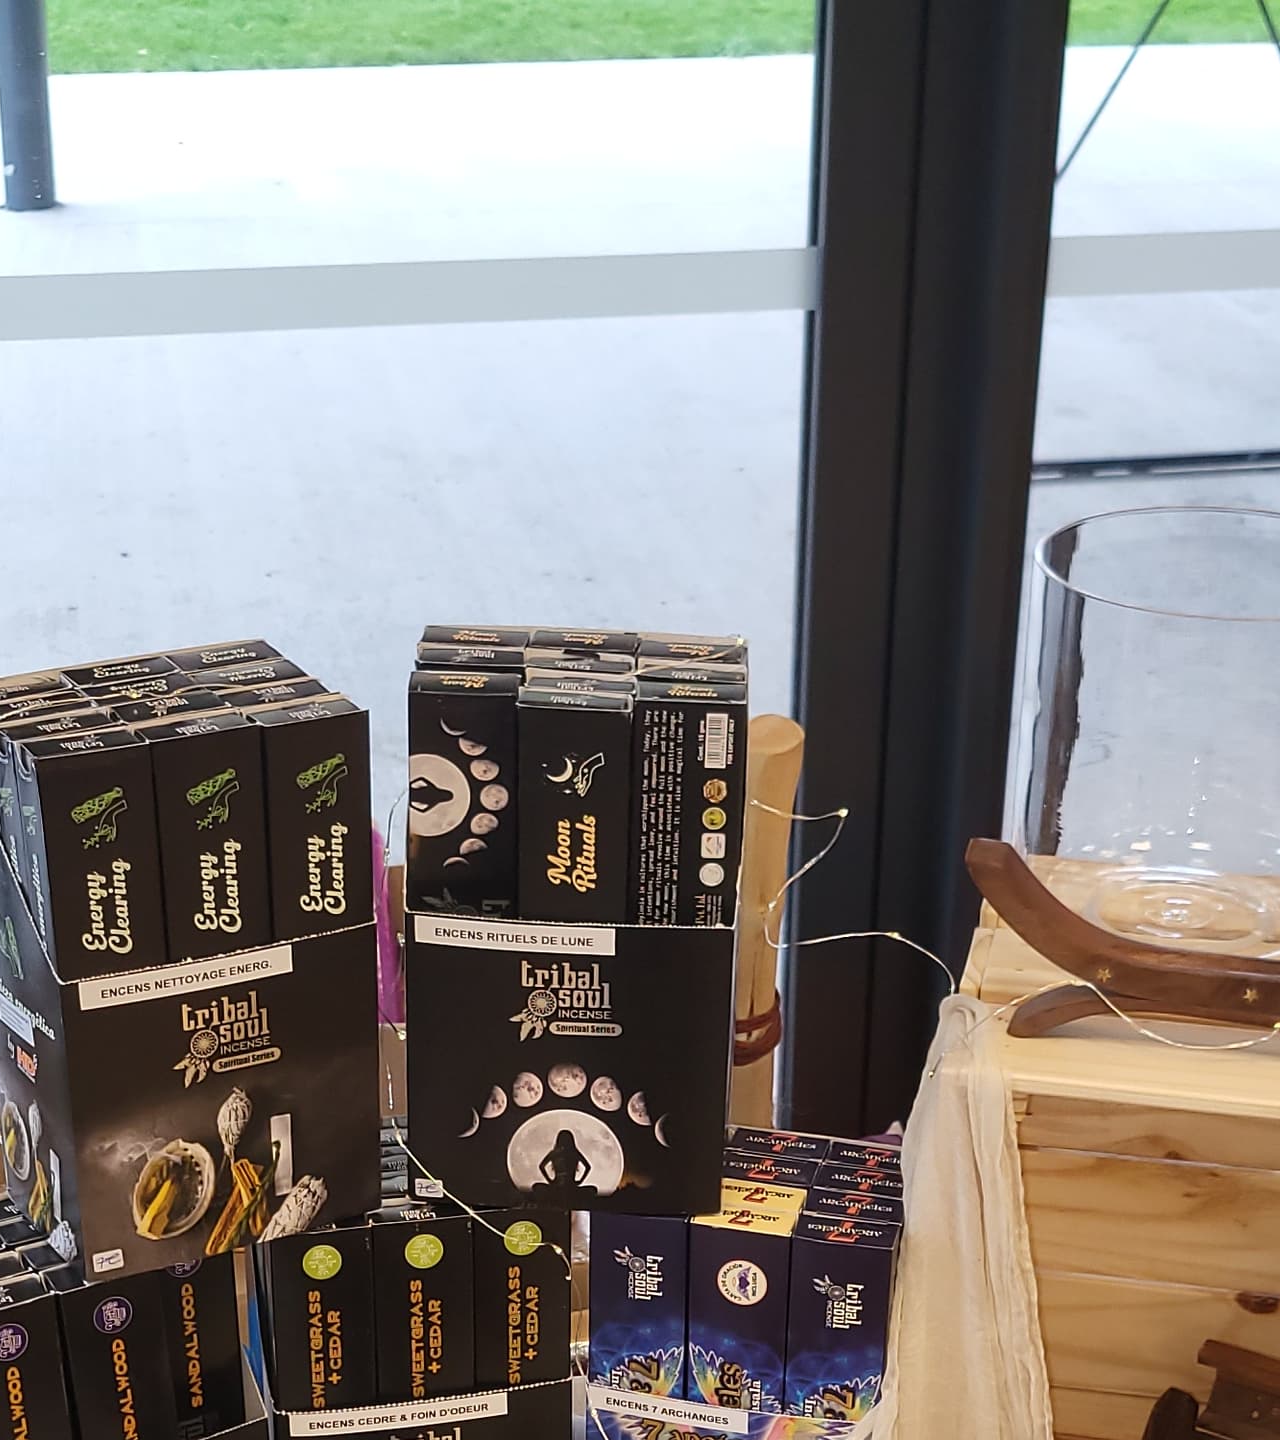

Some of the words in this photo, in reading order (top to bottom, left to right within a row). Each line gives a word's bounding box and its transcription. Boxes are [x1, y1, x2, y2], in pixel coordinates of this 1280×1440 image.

[322, 822, 348, 915] Clearing
[547, 818, 571, 885] Moon
[572, 814, 597, 892] Rituals
[194, 851, 219, 930] Energy
[218, 838, 243, 933] Clearing
[299, 834, 326, 913] Energy
[82, 871, 108, 951] Energy
[107, 858, 133, 954] Clearing
[435, 927, 483, 940] ENCENS
[487, 931, 538, 945] RITUELS
[541, 936, 558, 945] DE
[561, 937, 594, 947] LUNE
[100, 982, 151, 999] ENCENS
[154, 968, 227, 991] NETTOYAGE
[229, 960, 273, 977] ENERG.
[521, 960, 600, 989] tribal
[558, 982, 612, 1009] soul
[181, 990, 260, 1032] tribal
[220, 1007, 270, 1044] soul
[558, 1010, 612, 1019] INCENSE
[220, 1036, 271, 1055] INCENSE
[635, 1272, 651, 1300] soul
[646, 1255, 663, 1297] tribal
[508, 1265, 522, 1384] SWEETGRASS
[832, 1301, 850, 1329] soul
[846, 1284, 864, 1326] tribal
[181, 1283, 203, 1408] SANDALWOOD
[308, 1290, 326, 1409] SWEETGRASS
[410, 1279, 425, 1398] SWEETGRASS
[309, 1419, 355, 1430] ENCENS
[358, 1414, 395, 1426] CEDRE
[400, 1414, 407, 1422] &
[411, 1410, 436, 1421] FOIN
[440, 1403, 489, 1417] D'ODEUR
[606, 1397, 648, 1412] ENCENS
[652, 1405, 658, 1413] 7
[661, 1407, 729, 1425] ARCHANGES
